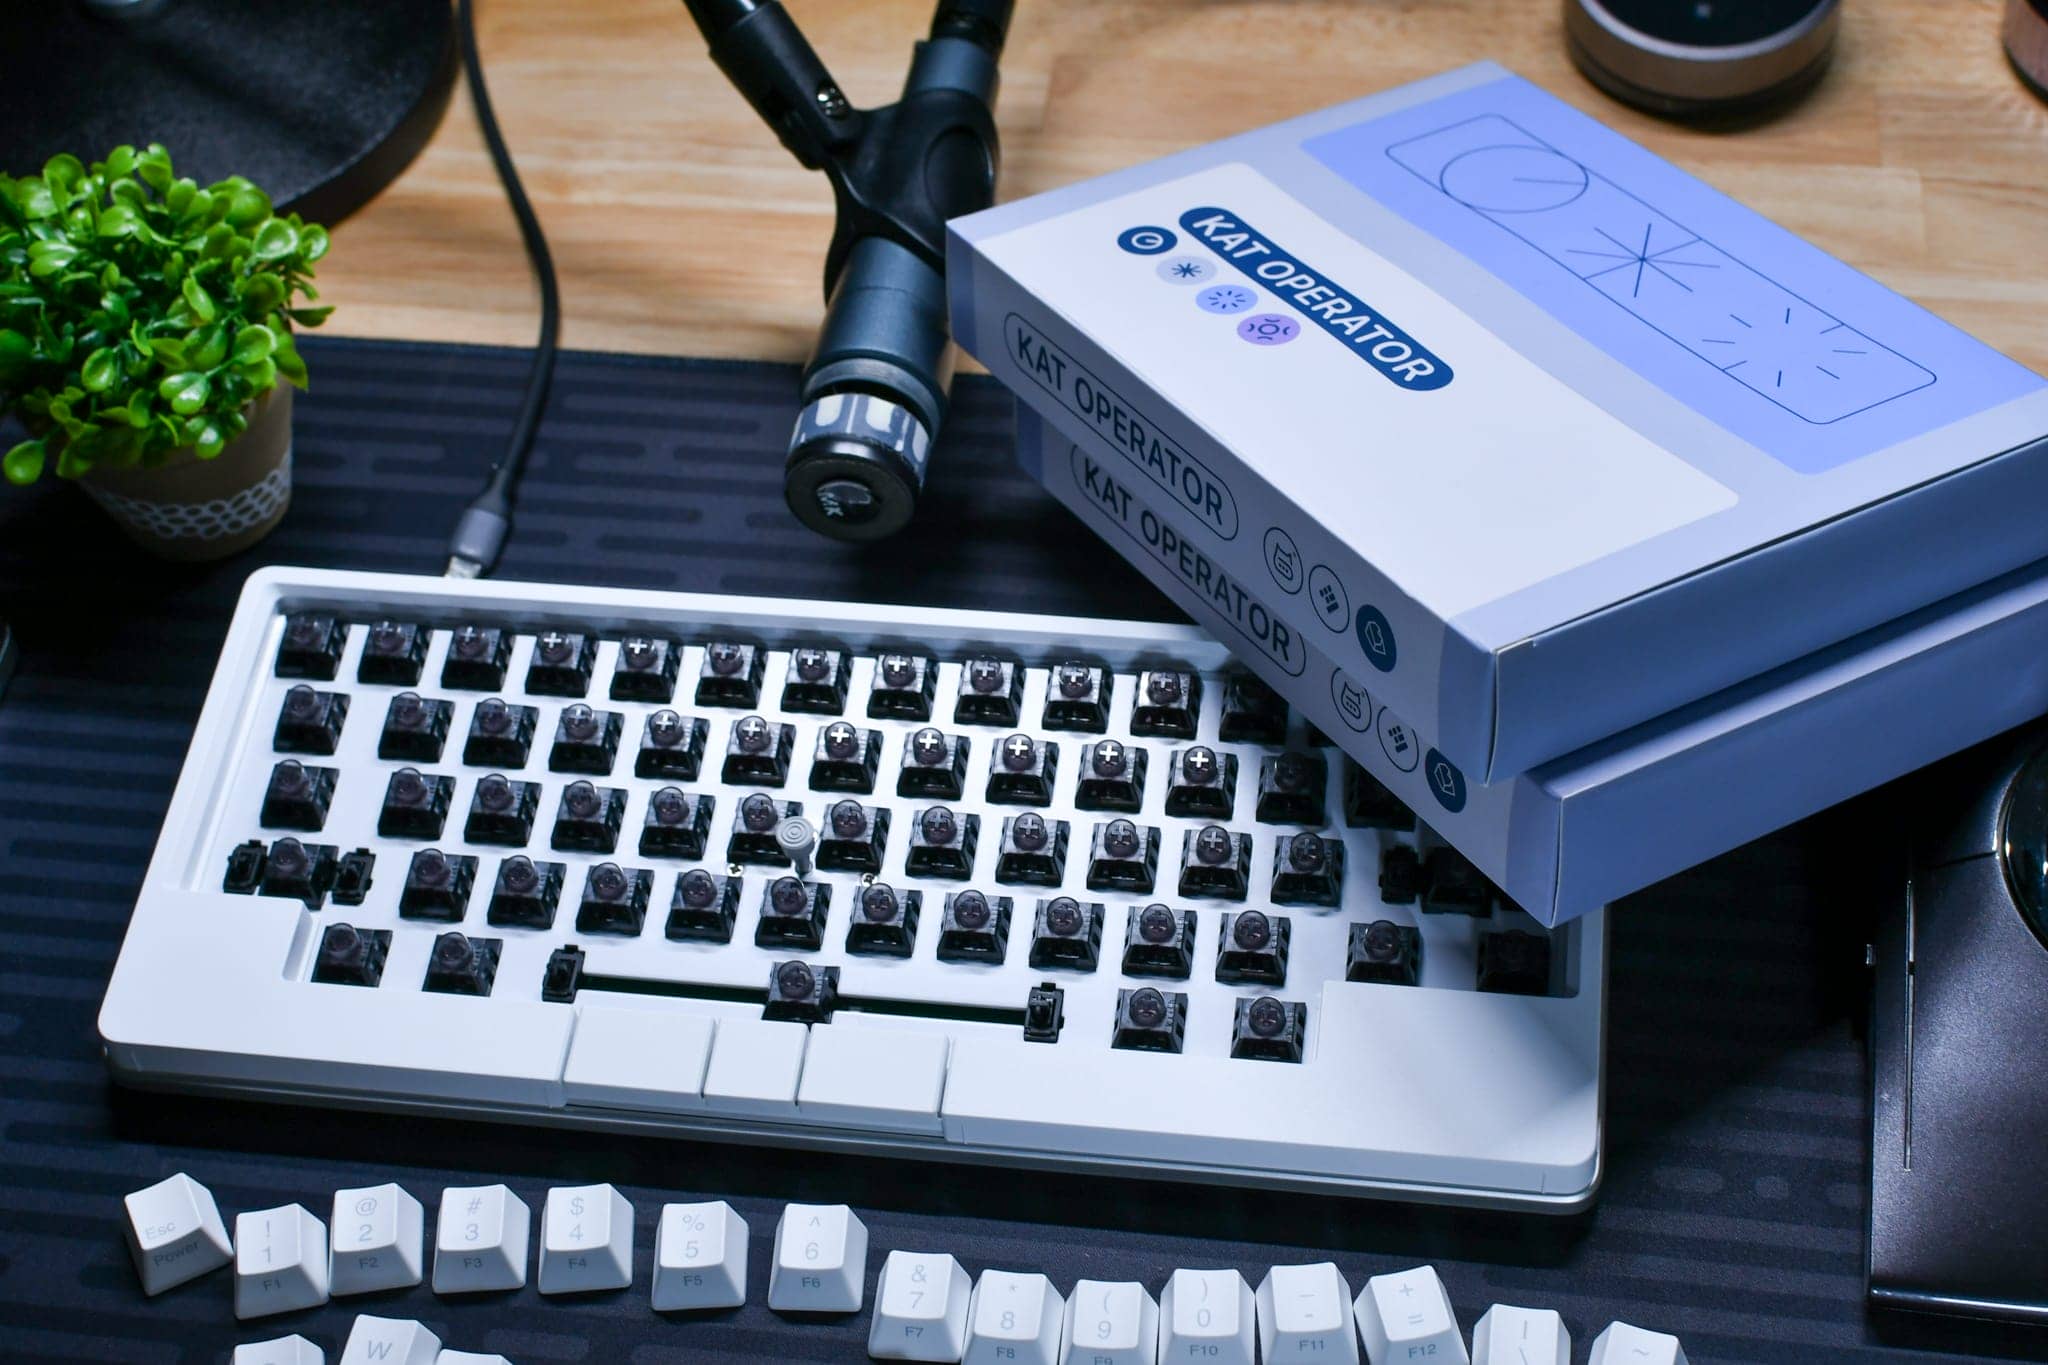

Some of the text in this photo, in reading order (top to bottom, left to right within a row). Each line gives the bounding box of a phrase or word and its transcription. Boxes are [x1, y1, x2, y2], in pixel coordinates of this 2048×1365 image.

[1193, 214, 1436, 384] KAT OPERATOR
[1018, 326, 1224, 527] KAT OPERATOR
[1083, 456, 1291, 664] KAT OPERATOR
[144, 1221, 178, 1240] Esc
[358, 1223, 374, 1243] 2
[464, 1223, 479, 1242] 3
[569, 1223, 584, 1241] 4
[153, 1241, 200, 1268] Power
[260, 1246, 272, 1265] 1
[685, 1240, 699, 1259] 5
[804, 1241, 819, 1261] 6
[358, 1256, 379, 1270] F2
[463, 1257, 483, 1269] F3
[567, 1257, 587, 1270] F4
[263, 1279, 282, 1293] F1
[683, 1276, 703, 1288] F5
[801, 1276, 821, 1289] F6
[909, 1290, 925, 1310] 7
[999, 1310, 1015, 1331] 8
[1196, 1308, 1212, 1329] 0
[904, 1325, 924, 1338] F7
[1097, 1320, 1112, 1340] 9
[367, 1340, 393, 1361] W
[996, 1346, 1016, 1359] F8
[1189, 1344, 1219, 1356] F10
[1298, 1339, 1324, 1352] F11
[1408, 1343, 1437, 1359] F12
